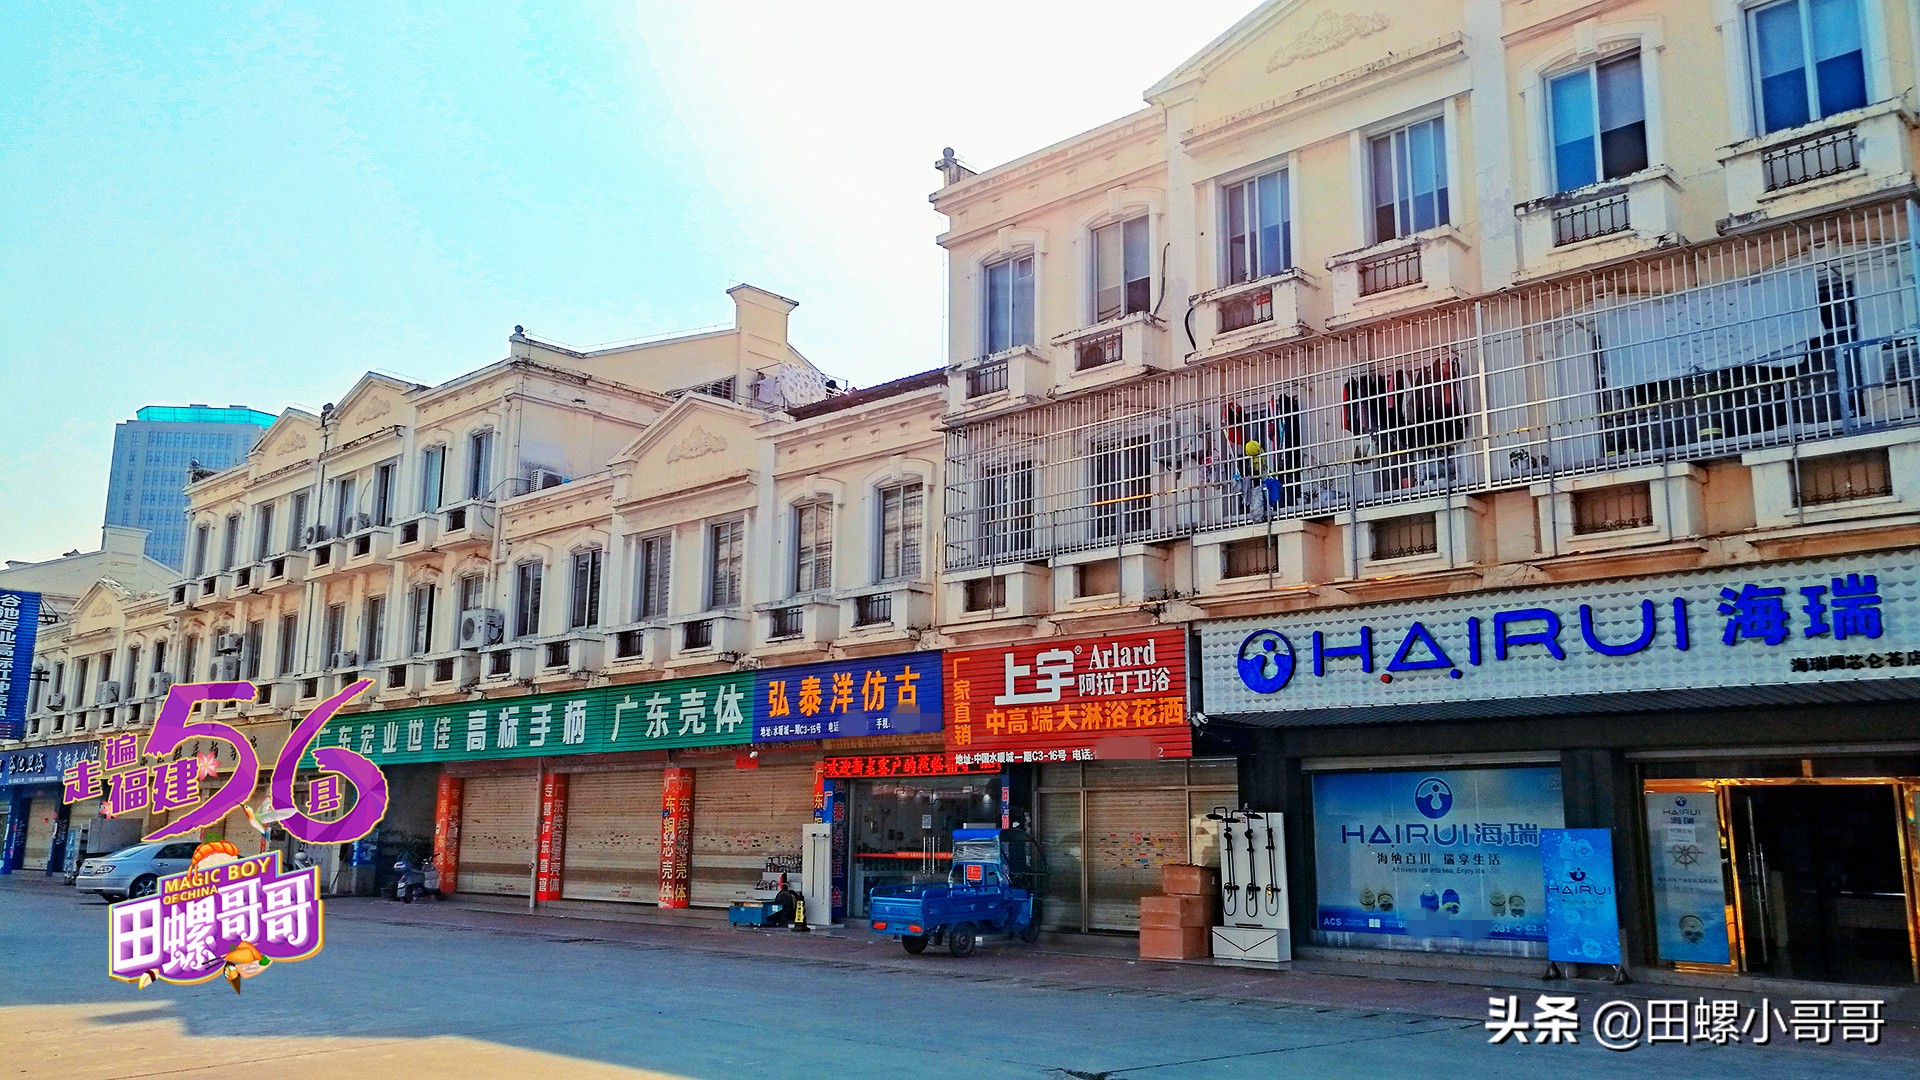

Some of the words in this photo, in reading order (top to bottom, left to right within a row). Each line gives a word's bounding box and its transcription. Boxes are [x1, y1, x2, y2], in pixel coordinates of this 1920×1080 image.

[1312, 597, 1690, 682] HAIRUI
[1716, 573, 1884, 646] 海瑞
[1088, 639, 1157, 671] Arlard
[768, 666, 920, 717] 弘泰洋仿古
[994, 649, 1075, 705] 上宇
[1079, 667, 1170, 696] 阿拉丁卫浴
[466, 700, 587, 751] 高标手柄
[611, 684, 744, 741] 广东壳体
[953, 657, 972, 745] 厂家直销
[986, 697, 1184, 735] 中高端大淋浴花洒
[1341, 823, 1469, 848] HAIRUI
[1474, 822, 1539, 846] 海瑞
[1376, 852, 1431, 865] 海纳百川
[1443, 852, 1501, 866] 瑞享生活
[1547, 885, 1612, 895] HAIRUI
[1323, 917, 1342, 926] ACS
